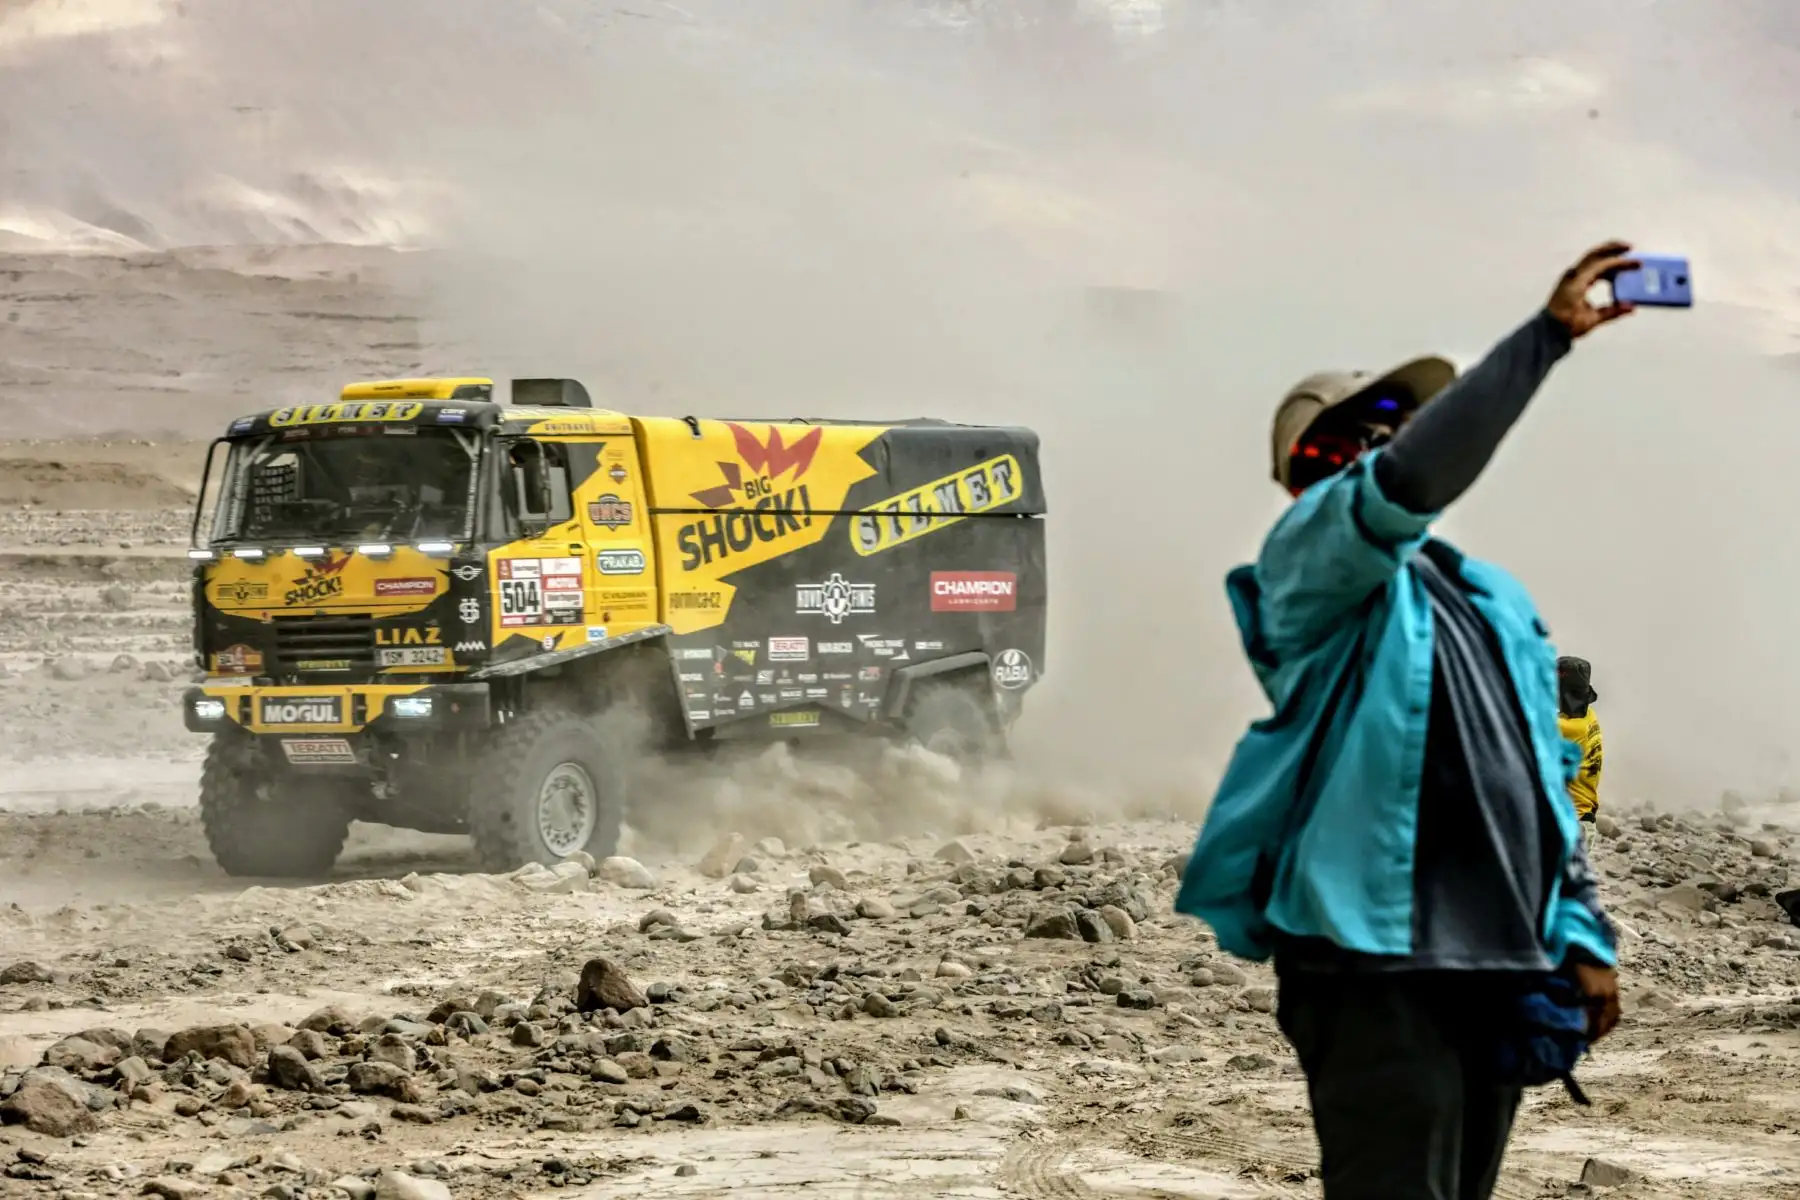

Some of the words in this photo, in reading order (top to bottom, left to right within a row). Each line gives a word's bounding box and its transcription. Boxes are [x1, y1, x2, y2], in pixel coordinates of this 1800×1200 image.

[274, 402, 416, 425] SILMET
[743, 474, 773, 500] BIG
[856, 458, 1016, 553] SILMET
[677, 483, 813, 572] SHOCK!
[285, 575, 343, 606] SHOCK!
[376, 581, 435, 590] CHAMPION
[502, 580, 540, 613] 504
[933, 580, 1013, 595] CHAMPION
[375, 626, 442, 645] LIAZ
[264, 704, 340, 722] MOGUL
